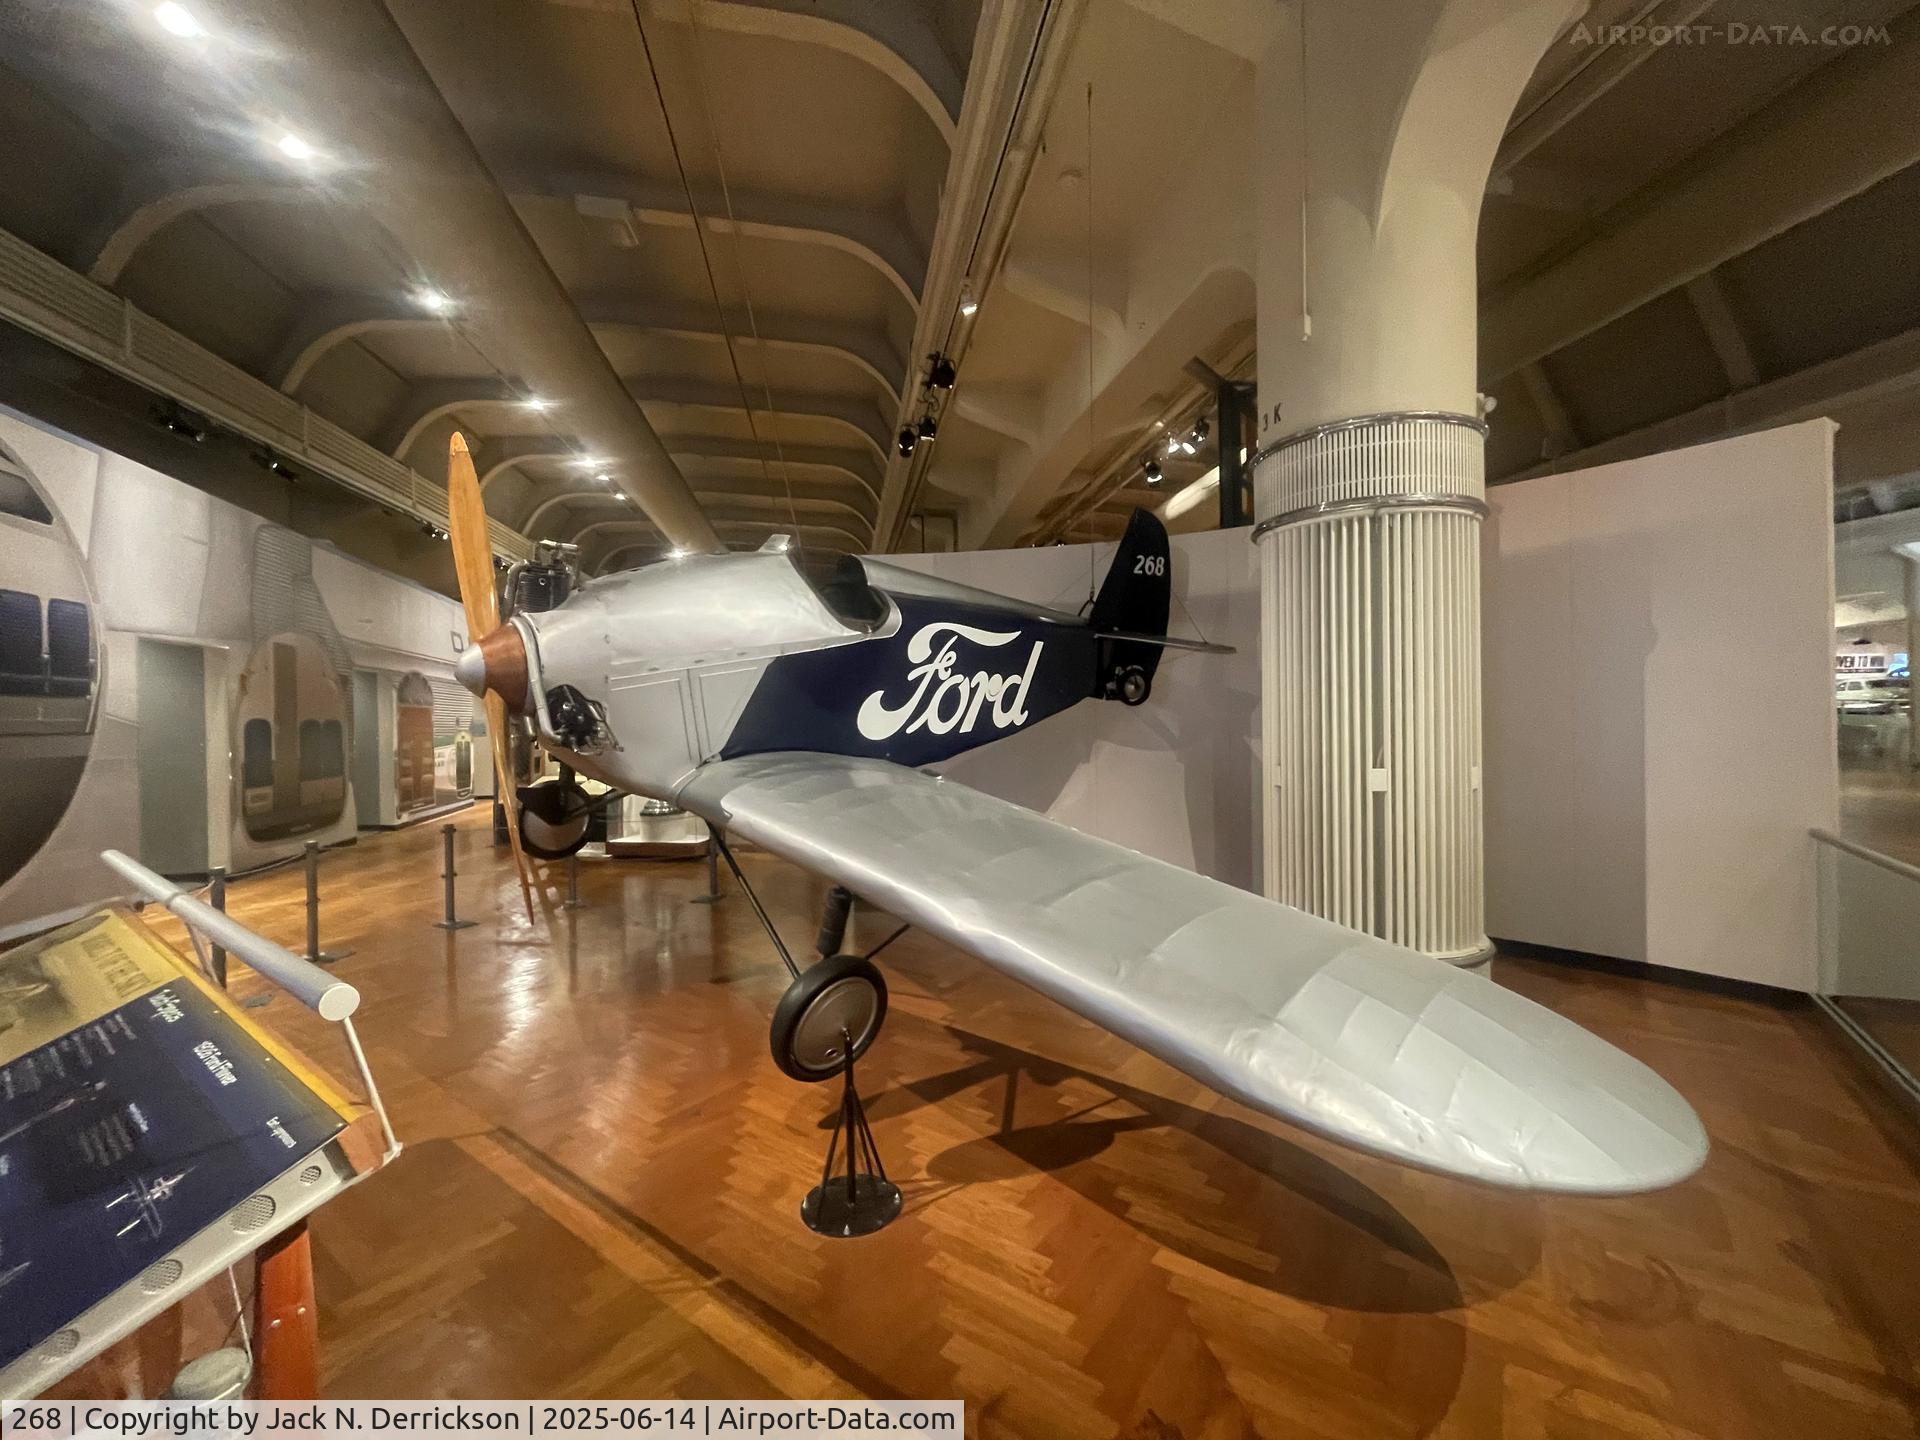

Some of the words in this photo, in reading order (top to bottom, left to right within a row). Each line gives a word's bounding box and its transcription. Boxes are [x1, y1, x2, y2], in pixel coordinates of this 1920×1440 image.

[1273, 402, 1283, 425] K
[1133, 555, 1165, 577] 268
[856, 622, 1044, 741] Ford
